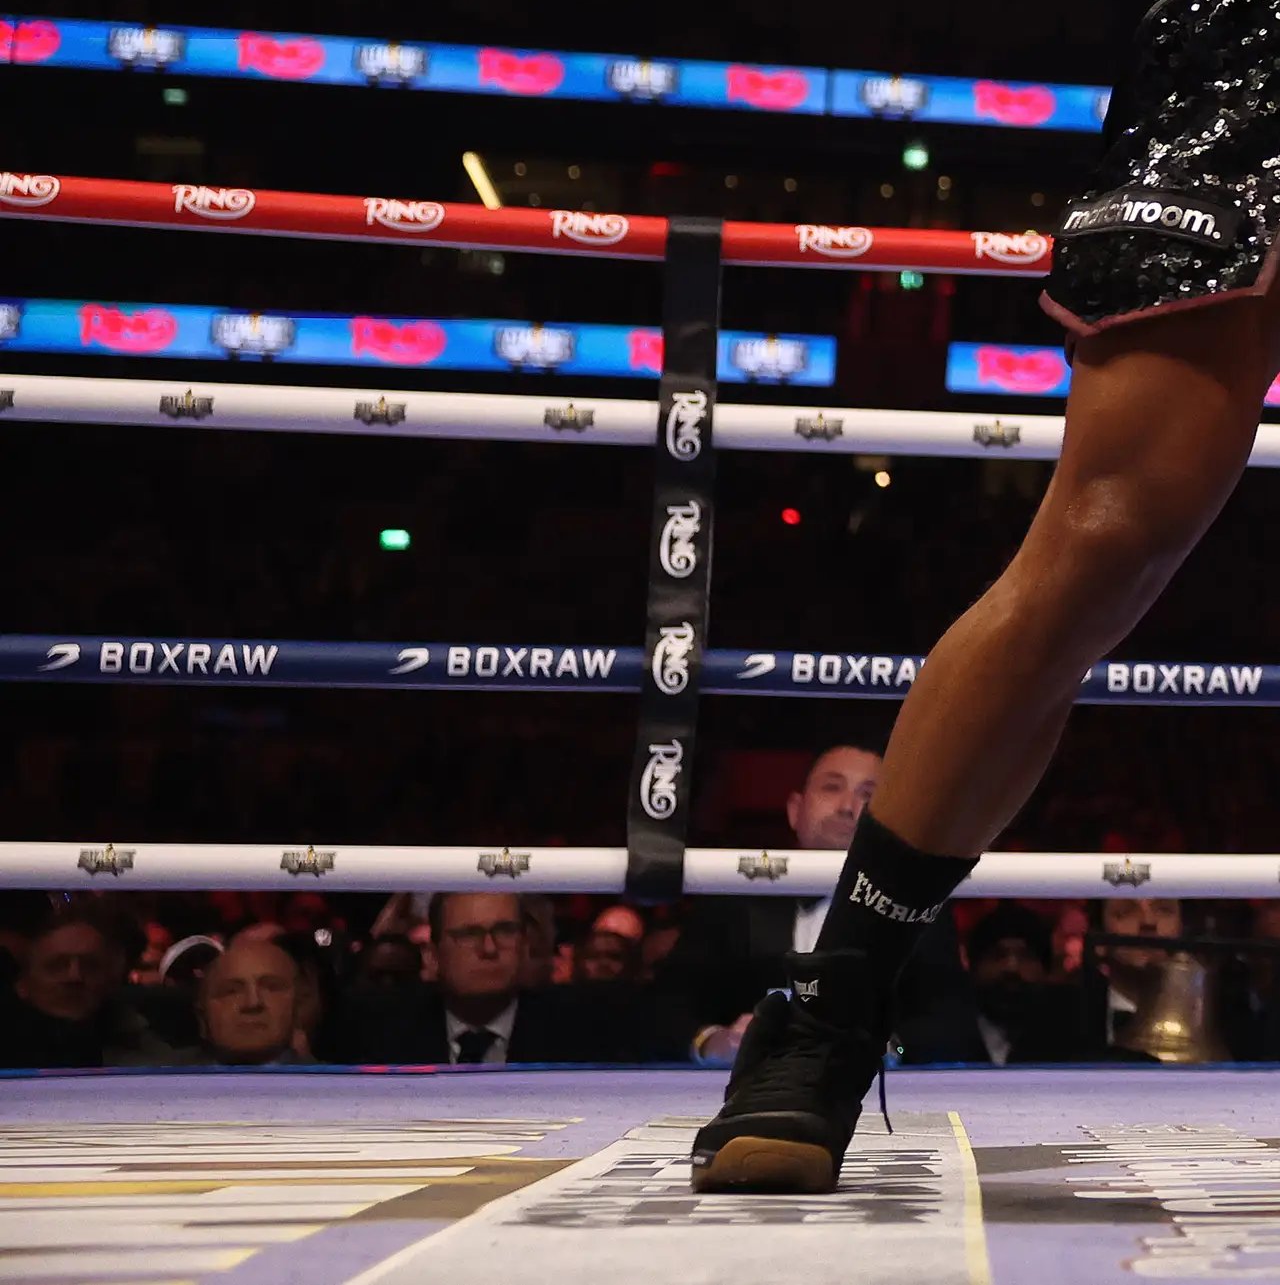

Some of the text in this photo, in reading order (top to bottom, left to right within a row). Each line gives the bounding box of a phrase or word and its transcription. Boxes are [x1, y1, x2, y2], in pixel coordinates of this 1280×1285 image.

[172, 184, 256, 220] RING
[364, 197, 445, 232] RING
[549, 210, 629, 245] RING
[795, 225, 873, 258] RING
[970, 232, 1048, 264] RING
[666, 390, 707, 462] RING
[659, 500, 700, 579] RING
[100, 642, 278, 677] BOXRAW
[447, 647, 616, 680] BOXRAW
[652, 621, 695, 695] RING
[791, 653, 925, 685] BOXRA
[1107, 664, 1262, 695] BOXRAW
[640, 738, 684, 820] RING
[850, 871, 944, 924] EVERLAS
